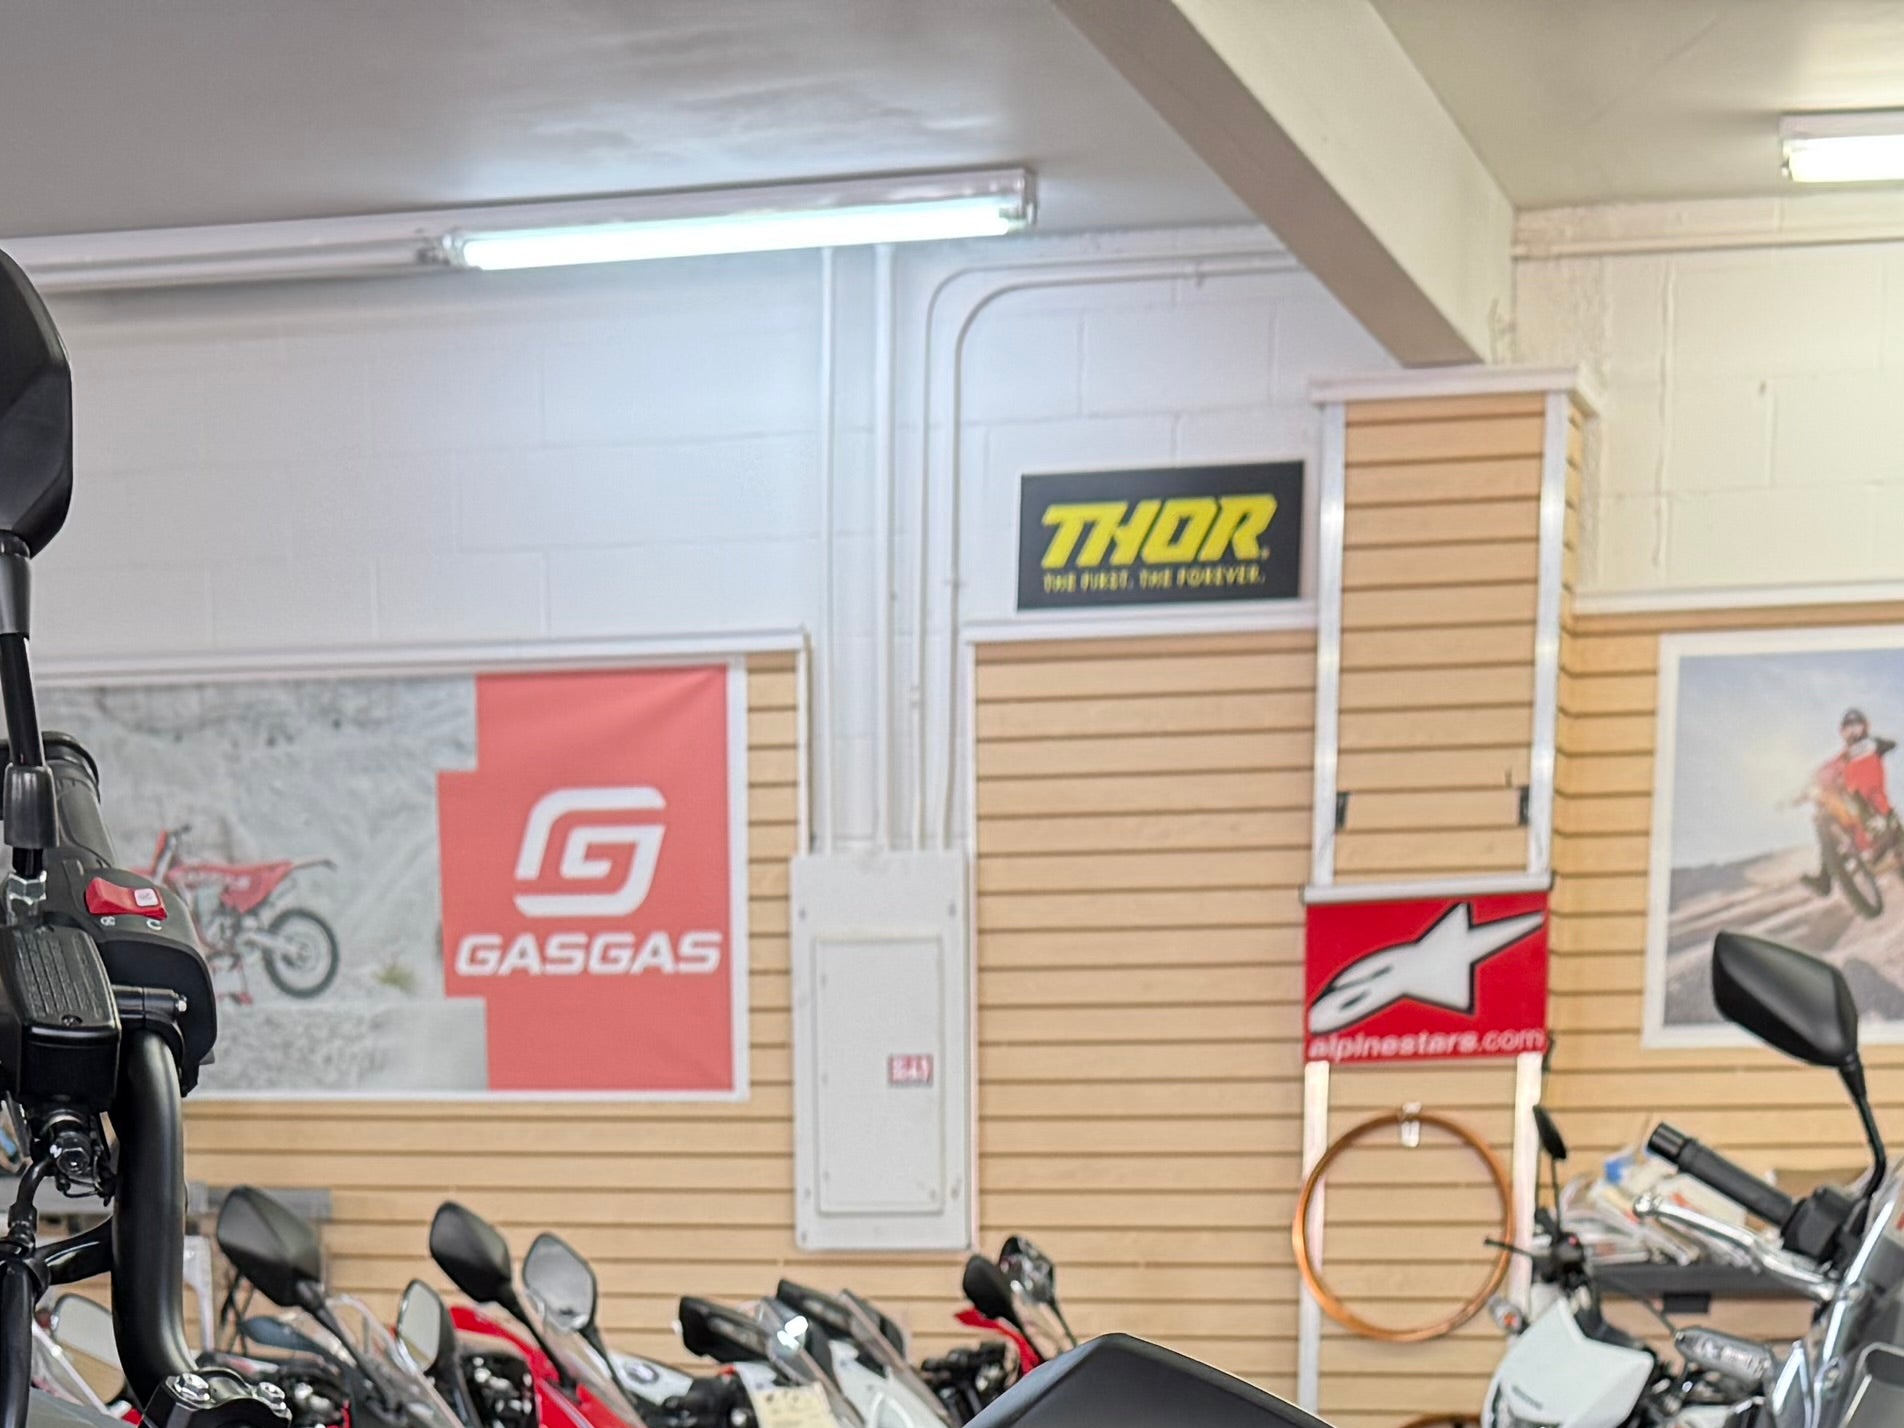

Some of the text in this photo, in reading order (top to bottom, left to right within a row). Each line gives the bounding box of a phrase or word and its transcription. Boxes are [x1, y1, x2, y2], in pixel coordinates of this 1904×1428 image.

[1041, 494, 1278, 569] THOR
[1043, 572, 1076, 592] THE
[1140, 568, 1172, 588] THE
[454, 930, 723, 977] GASGAS
[1308, 1027, 1546, 1062] alpinestars.com
